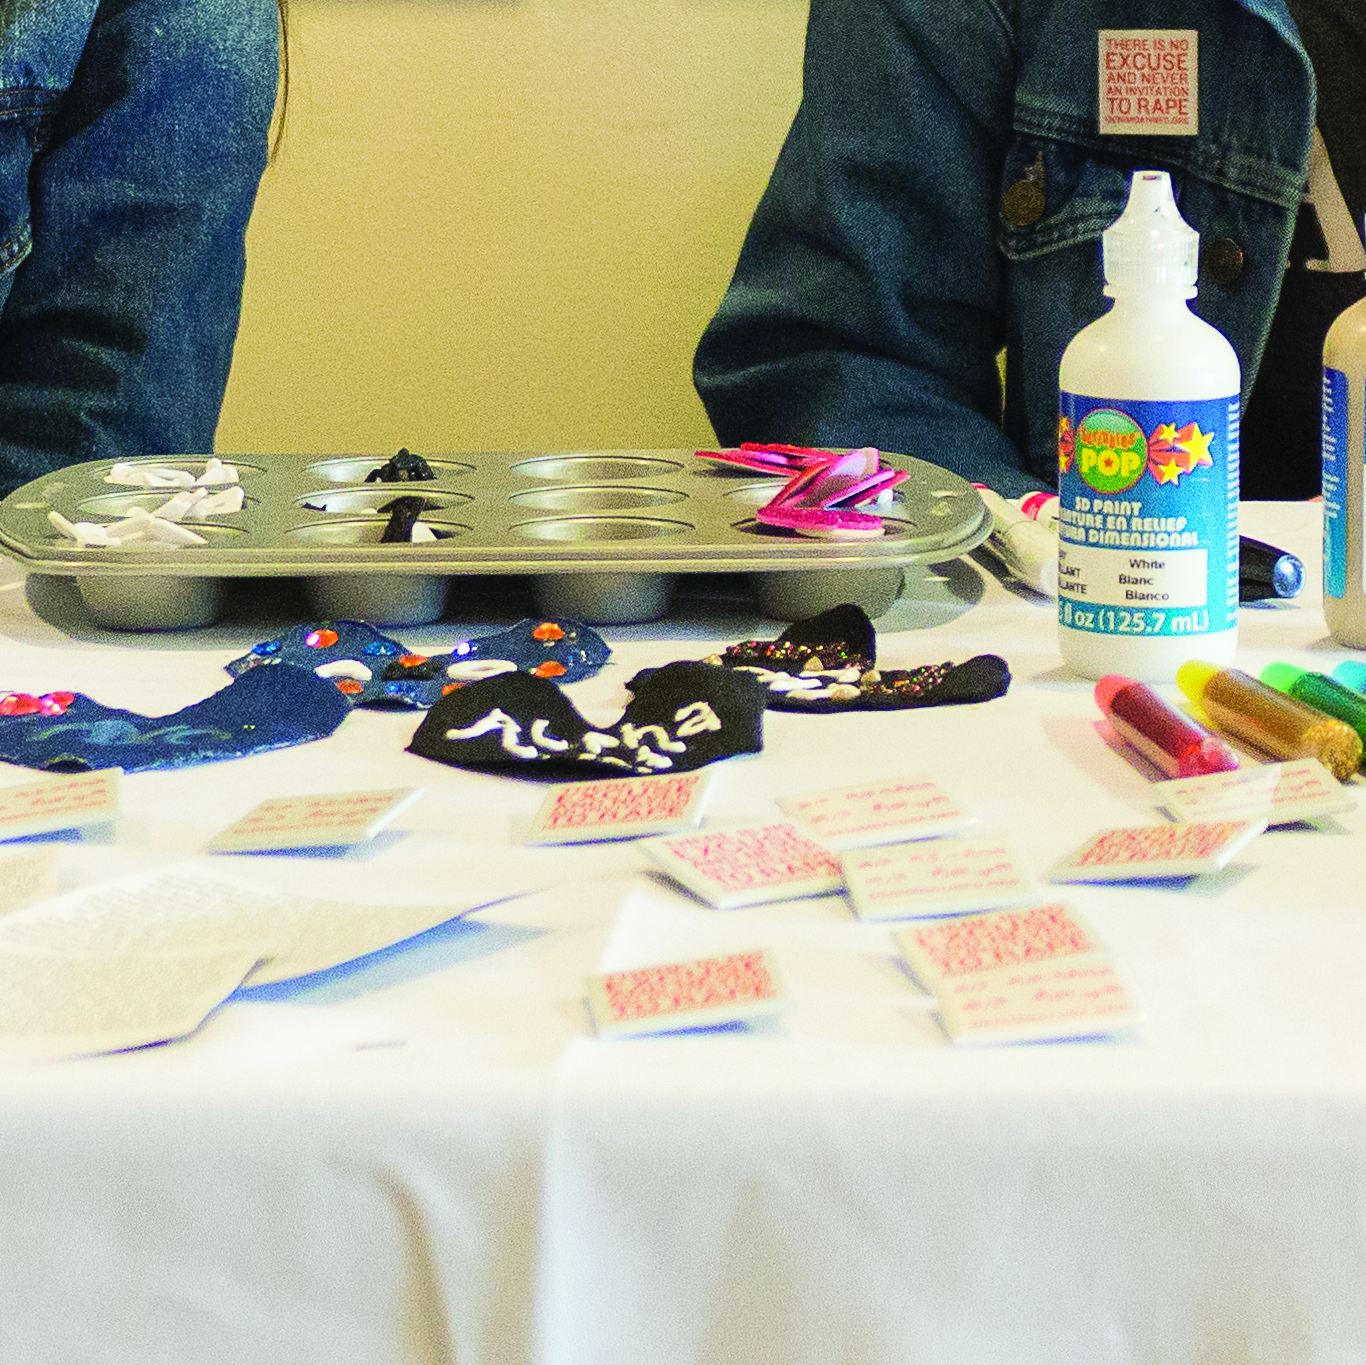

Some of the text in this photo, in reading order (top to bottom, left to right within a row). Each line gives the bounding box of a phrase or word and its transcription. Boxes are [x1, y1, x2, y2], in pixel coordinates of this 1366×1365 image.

[1106, 38, 1189, 51] THERE IS NO
[1105, 52, 1188, 71] EXCUSE
[1107, 72, 1188, 84] AND NEVER
[1106, 86, 1189, 97] AN INVITATION
[1106, 97, 1188, 115] TO RAPE
[1081, 448, 1140, 477] POP
[1093, 499, 1142, 515] PAINT
[1107, 516, 1187, 532] EN RELIEF
[1088, 529, 1199, 547] DIMENSIONAL
[1129, 558, 1165, 570] White
[1118, 574, 1154, 586] Blanc
[1125, 589, 1169, 601] Blanco
[1075, 612, 1094, 625] oz
[1099, 610, 1165, 632] (125.7
[1171, 609, 1209, 632] mL)
